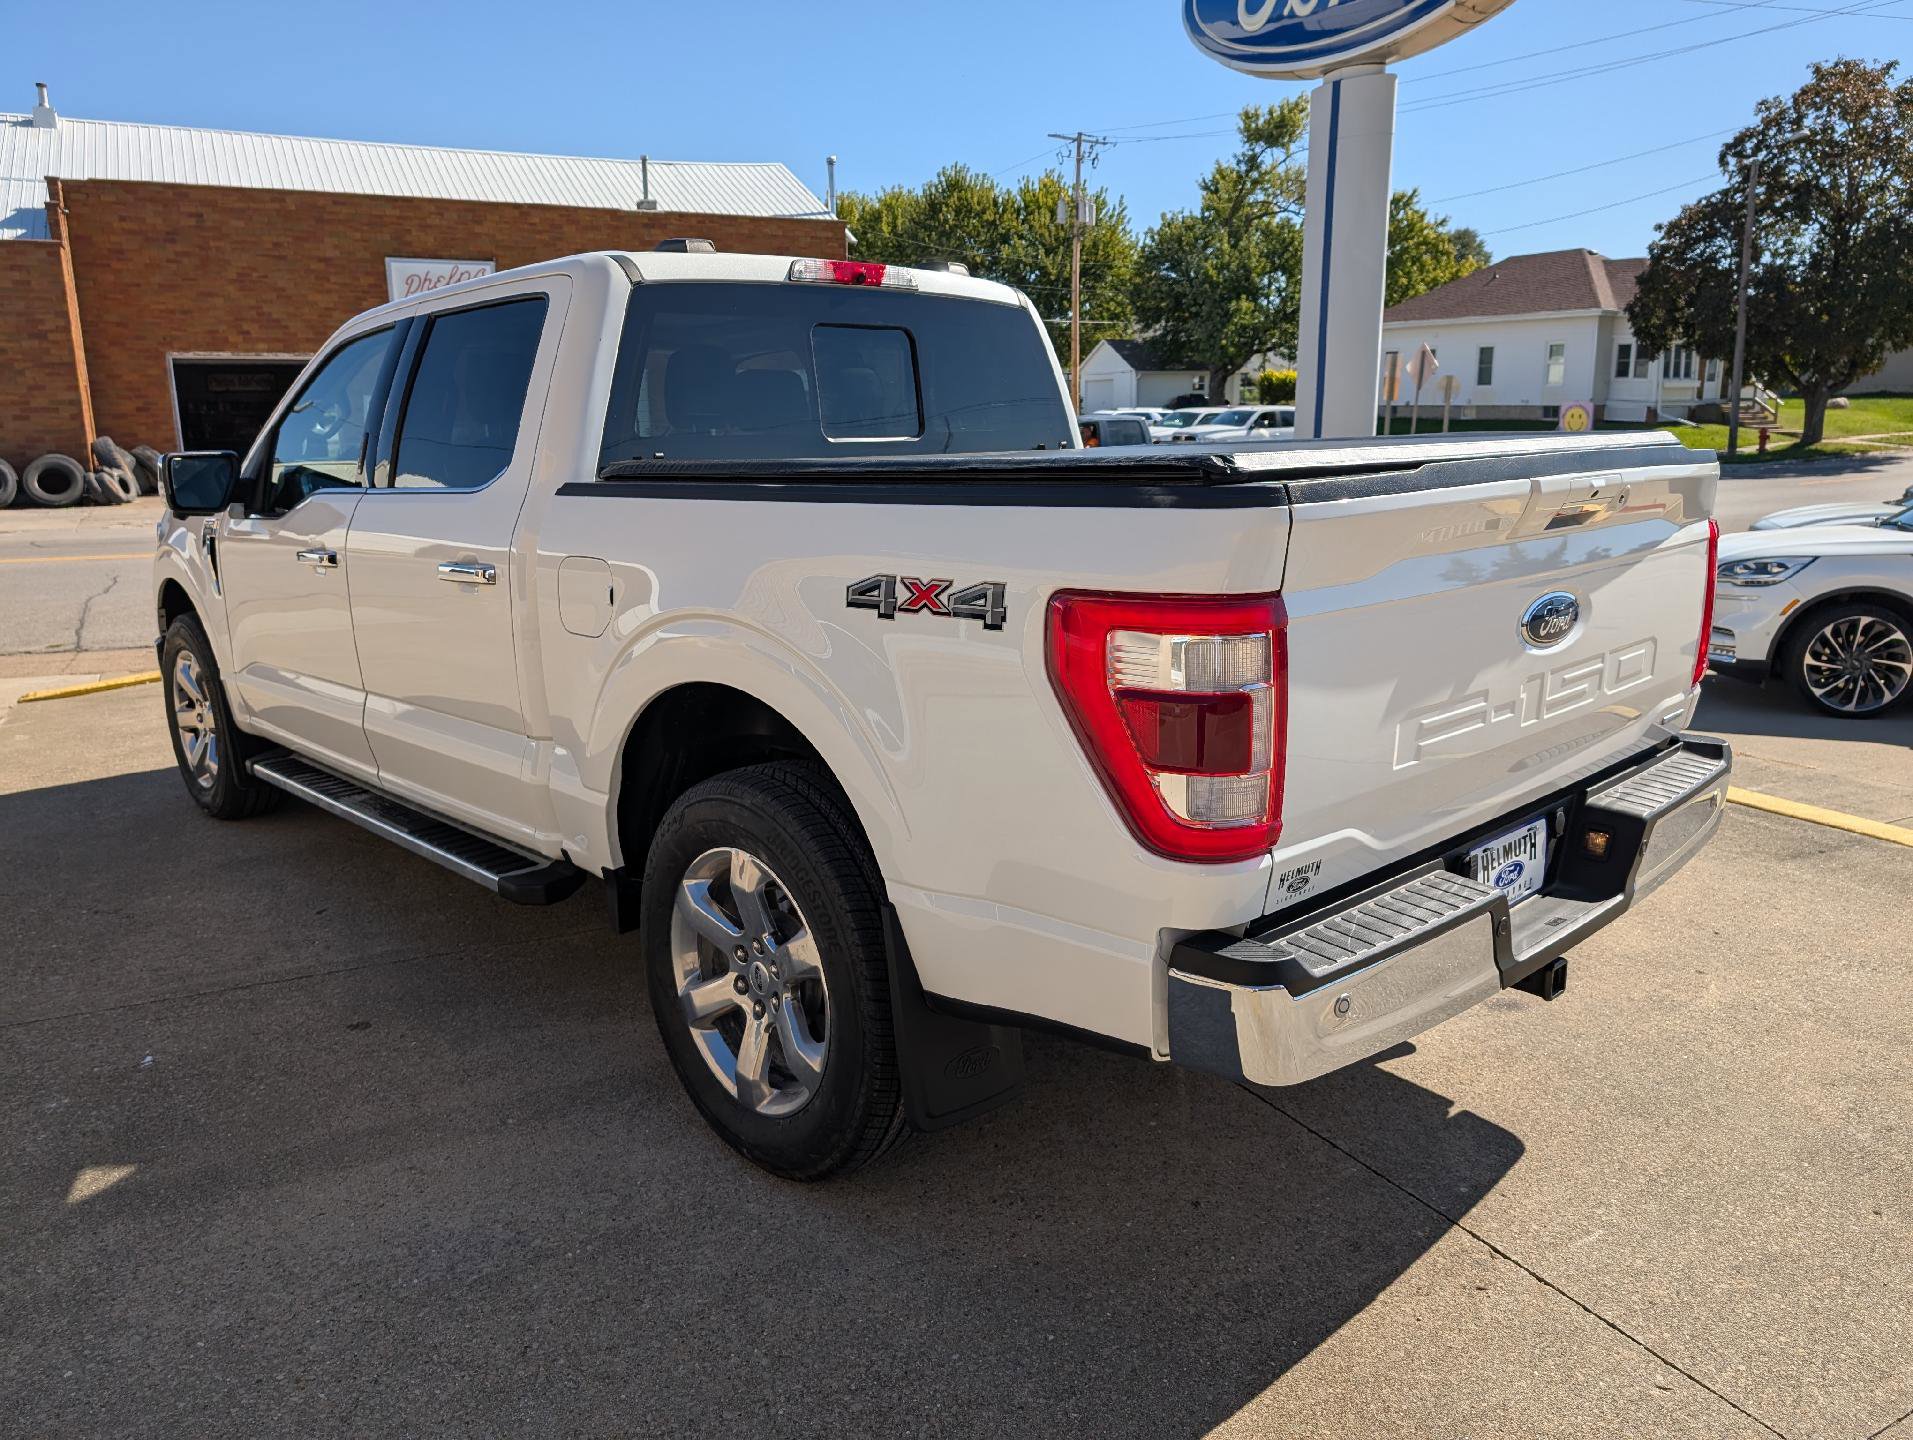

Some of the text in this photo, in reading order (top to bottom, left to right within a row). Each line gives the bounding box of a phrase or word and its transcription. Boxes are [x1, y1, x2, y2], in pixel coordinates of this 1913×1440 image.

[846, 573, 1007, 632] 4X4
[1540, 604, 1574, 637] Ford
[1393, 636, 1657, 771] F-150
[1278, 859, 1322, 890] HELMUTH
[1481, 831, 1537, 885] HELMUTH
